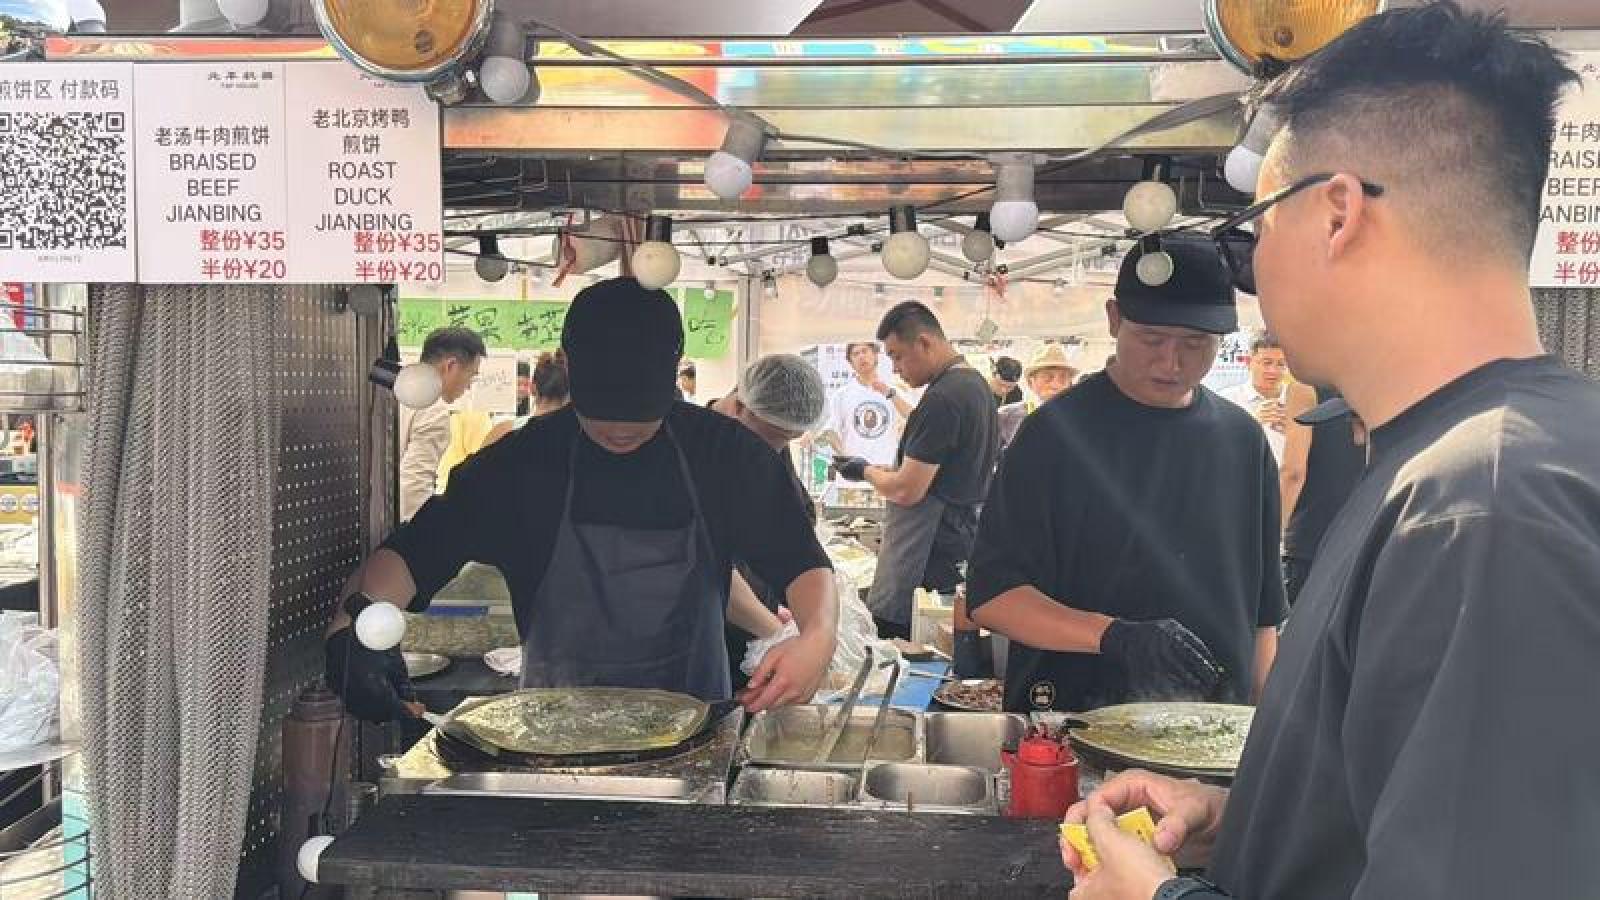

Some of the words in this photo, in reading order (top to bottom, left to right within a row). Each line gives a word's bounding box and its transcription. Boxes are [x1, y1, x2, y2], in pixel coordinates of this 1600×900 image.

[60, 79, 119, 100] 付款码
[313, 107, 410, 128] 老北京烤鸭
[154, 125, 270, 146] 老汤牛肉煎饼
[343, 134, 380, 154] 煎饼
[170, 153, 257, 171] BRAISED
[328, 161, 399, 179] ROAST
[187, 178, 240, 197] BEEF
[335, 187, 392, 205] DUCK
[165, 204, 262, 223] JIANBING
[314, 213, 413, 231] JIANBING
[199, 229, 286, 251] 整份¥35
[353, 232, 441, 253] 整份¥35
[1554, 231, 1600, 254] 整份
[201, 257, 287, 280] 半份¥20
[354, 260, 441, 282] 半份¥20
[1552, 261, 1600, 284] 半份
